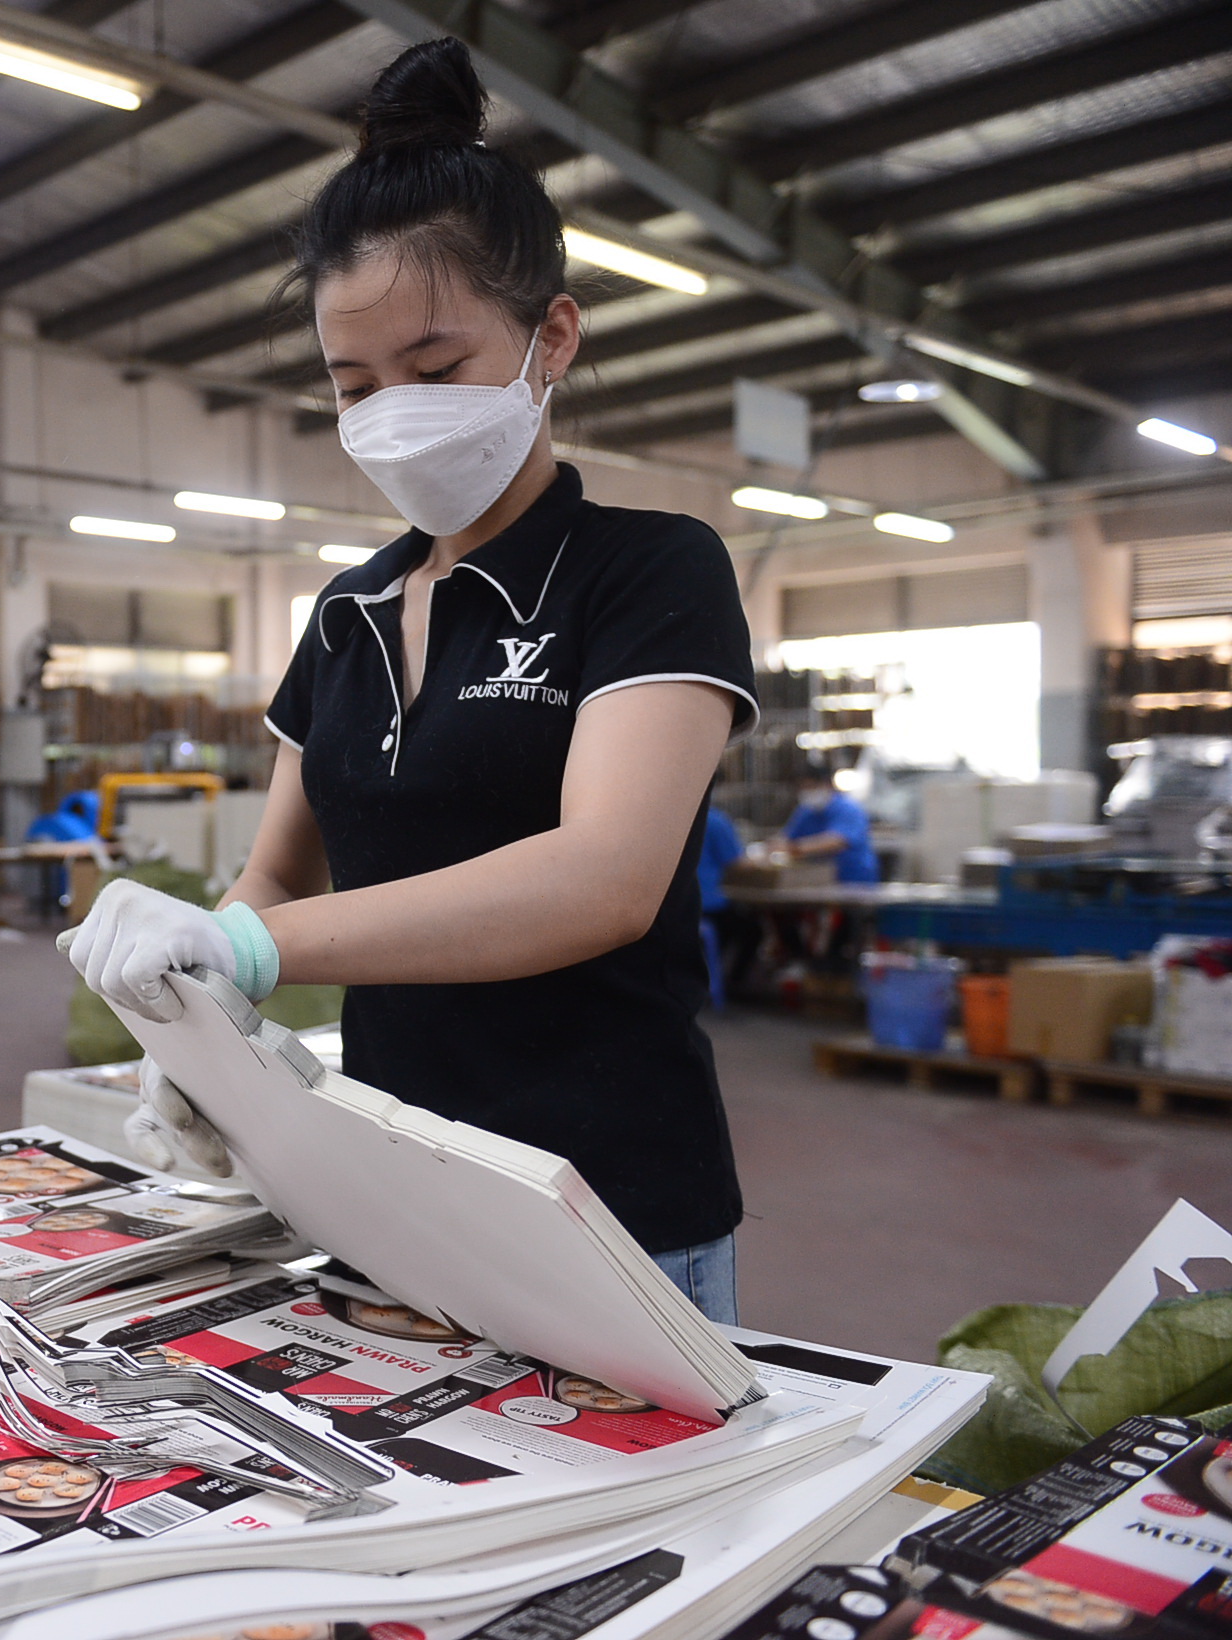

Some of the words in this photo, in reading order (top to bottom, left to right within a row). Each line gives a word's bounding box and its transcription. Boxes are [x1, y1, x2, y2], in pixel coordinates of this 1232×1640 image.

[259, 1317, 351, 1348] HARGOW
[279, 1347, 336, 1369] CHEN'S
[349, 1345, 431, 1373] PRAWN
[281, 1365, 313, 1378] MR
[412, 1387, 450, 1403] PRAWN
[425, 1388, 470, 1409] HARGOW
[527, 1410, 561, 1421] TASTY
[420, 1473, 456, 1486] PRA
